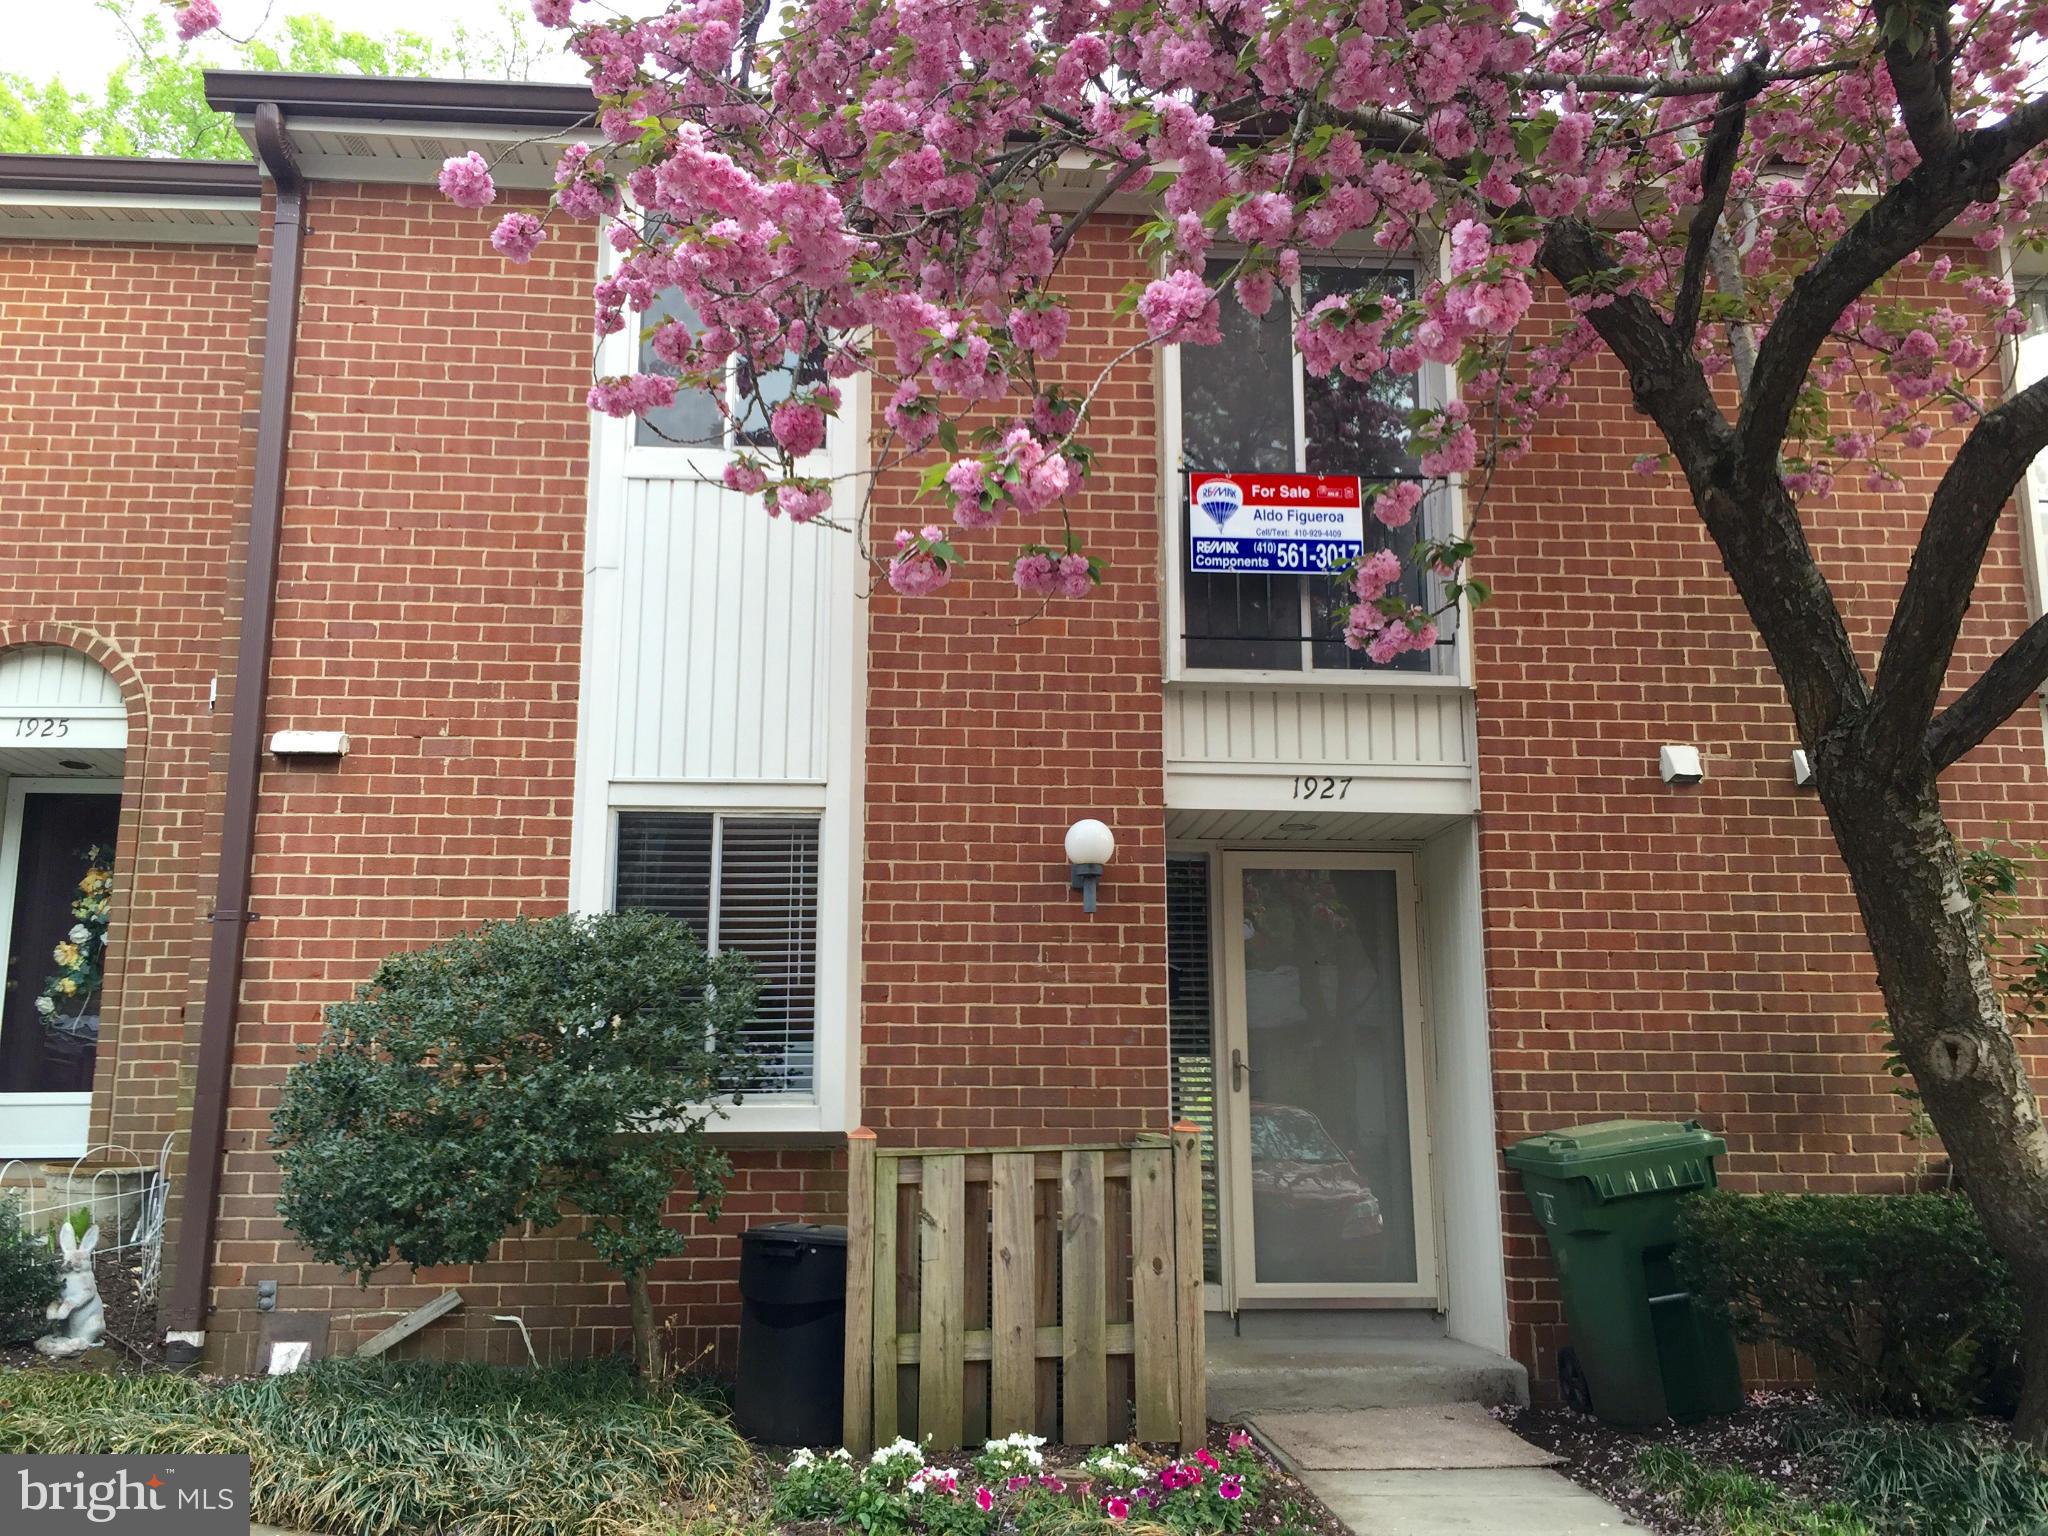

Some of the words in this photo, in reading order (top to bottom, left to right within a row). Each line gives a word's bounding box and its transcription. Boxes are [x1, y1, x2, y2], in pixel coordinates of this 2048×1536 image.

[1203, 487, 1237, 498] RE/MAX
[1251, 484, 1276, 498] For
[1279, 485, 1311, 499] Sale
[1253, 509, 1283, 522] Aldo
[1287, 510, 1344, 525] Figueroa
[1294, 529, 1342, 538] 410-929-4409
[1196, 541, 1239, 554] RE/MAX
[1253, 541, 1277, 555] (410)
[1277, 542, 1360, 568] 561-3017
[1195, 554, 1270, 569] Components
[16, 717, 70, 738] 1925
[1293, 776, 1353, 800] 1927
